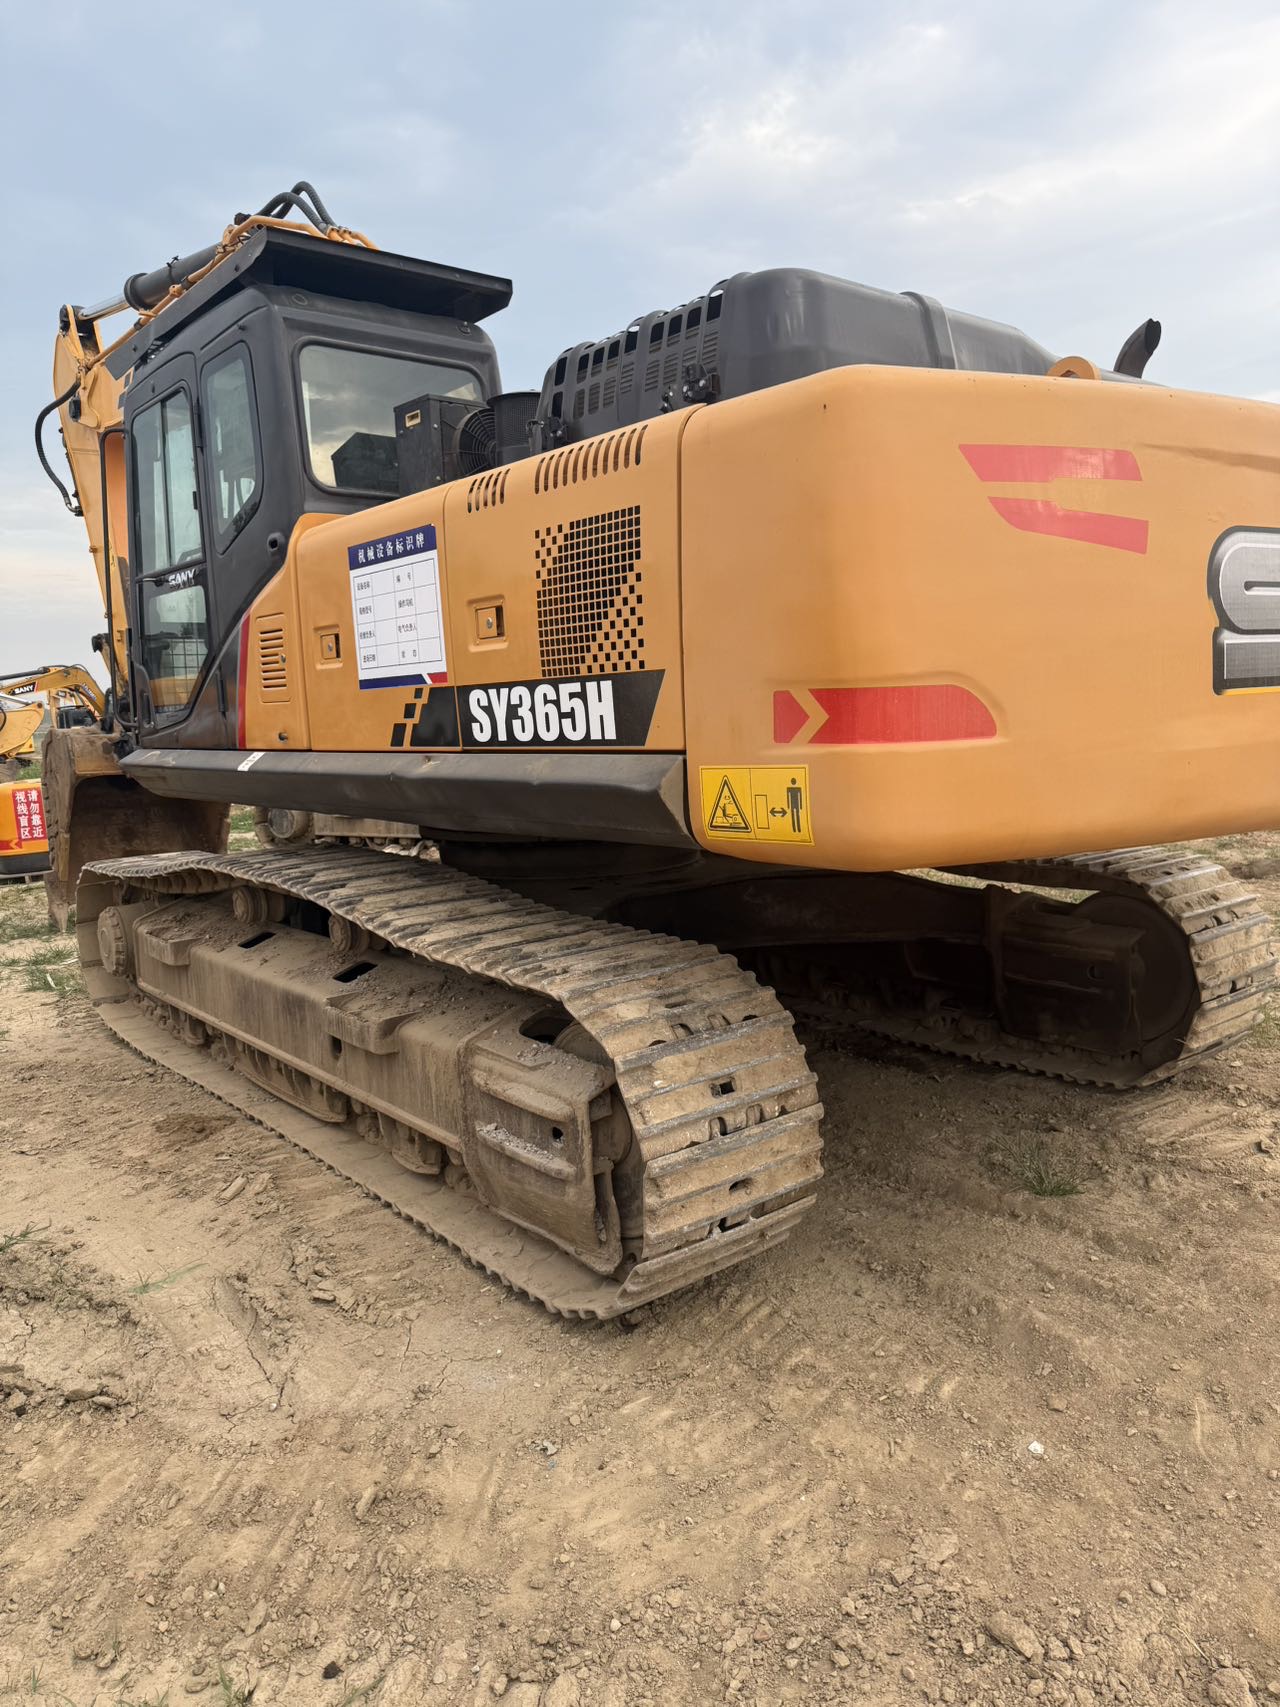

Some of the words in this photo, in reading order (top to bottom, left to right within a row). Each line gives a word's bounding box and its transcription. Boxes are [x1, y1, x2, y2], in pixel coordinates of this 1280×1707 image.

[358, 532, 425, 564] 机械设备标识牌
[168, 568, 196, 588] SANY
[14, 685, 34, 694] SANY
[468, 680, 617, 743] SY365H
[15, 791, 32, 840] 视线盲区
[27, 789, 44, 838] 请勿靠近
